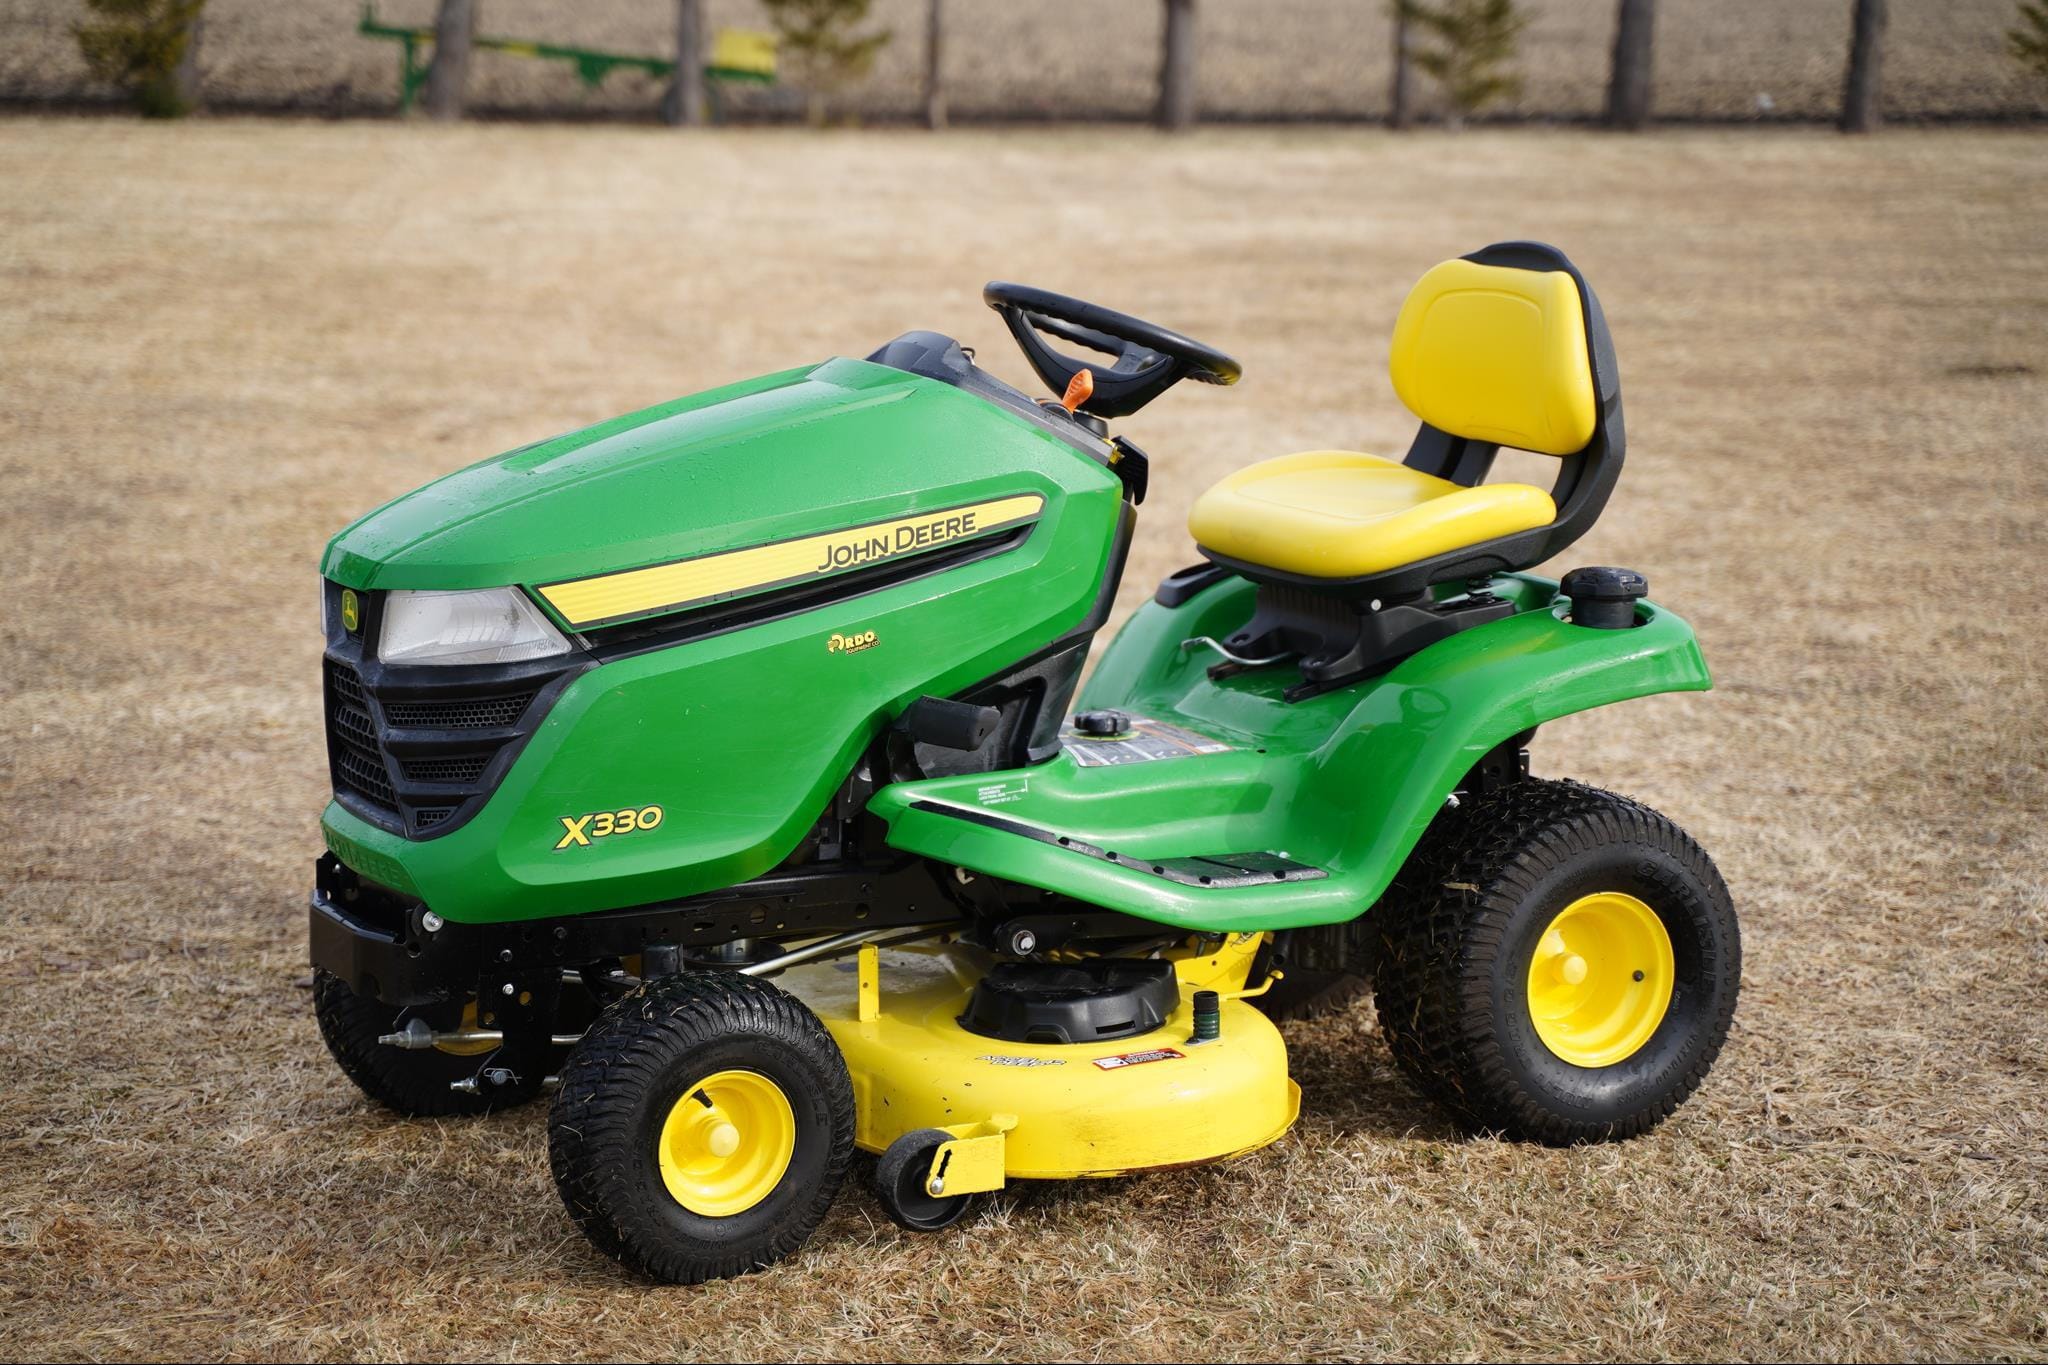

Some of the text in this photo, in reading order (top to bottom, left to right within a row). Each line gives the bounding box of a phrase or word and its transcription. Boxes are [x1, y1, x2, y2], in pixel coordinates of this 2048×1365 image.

[818, 512, 976, 571] JOHN DEERE
[552, 804, 664, 851] X330
